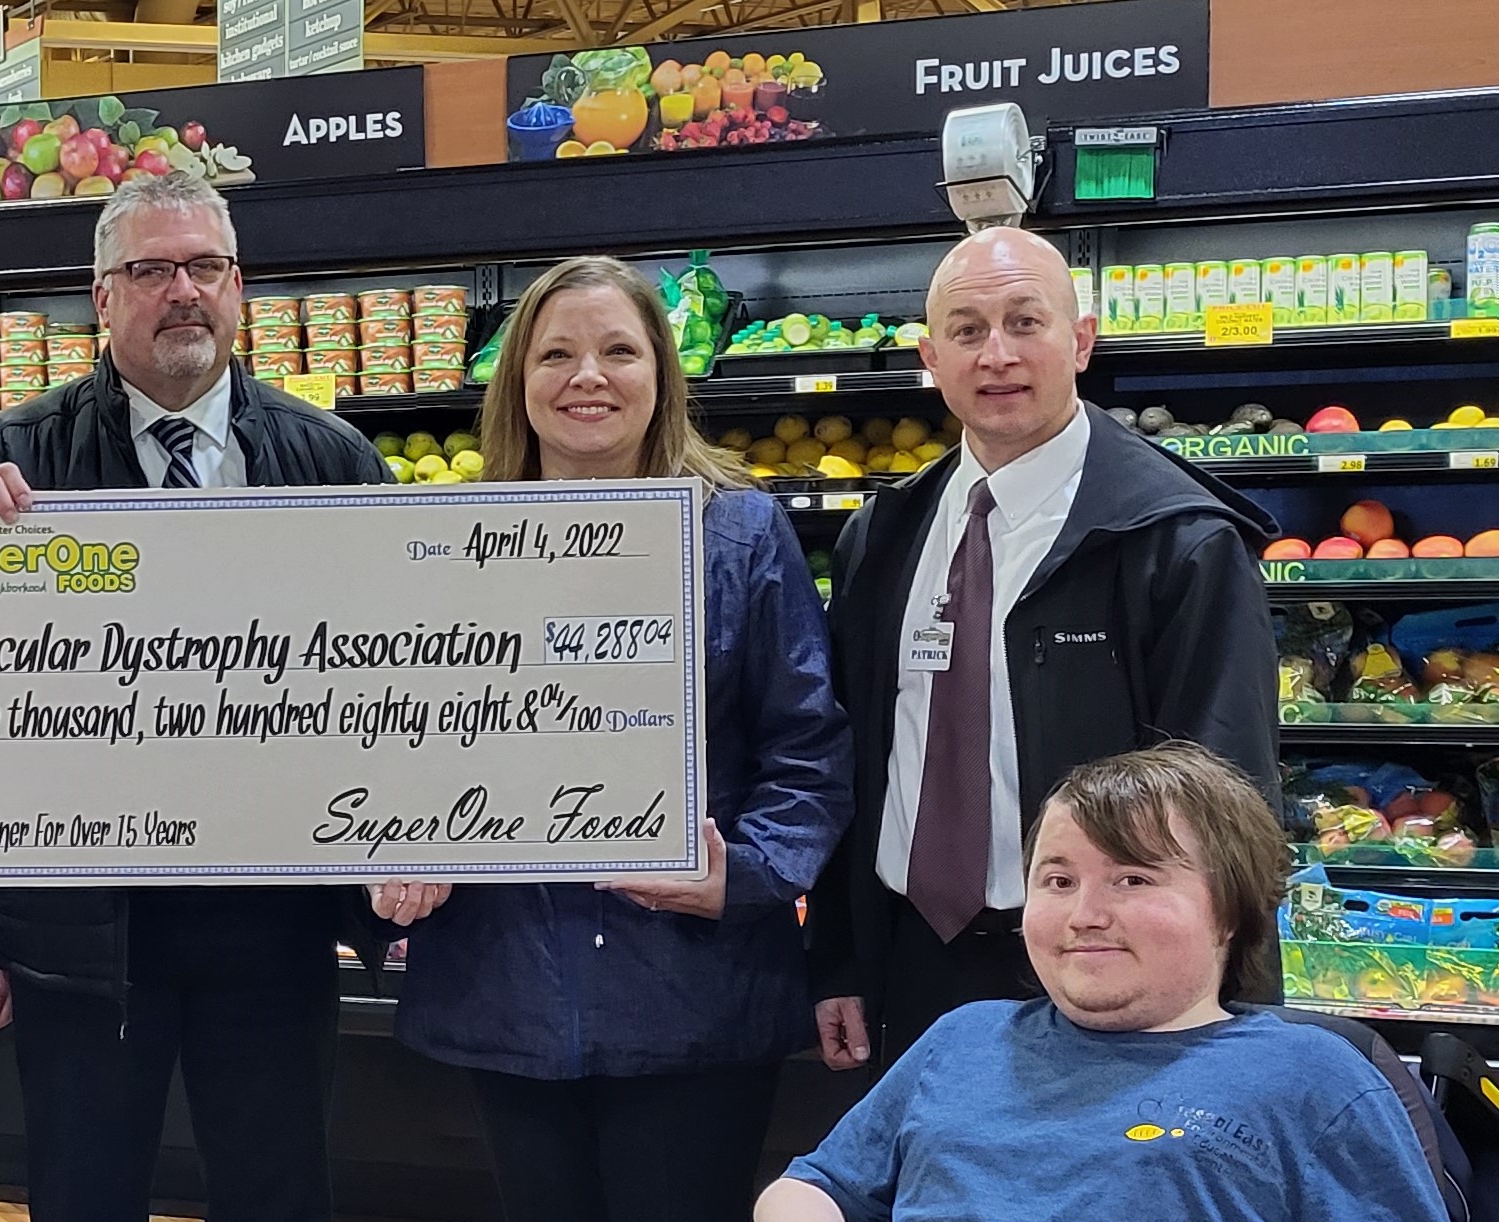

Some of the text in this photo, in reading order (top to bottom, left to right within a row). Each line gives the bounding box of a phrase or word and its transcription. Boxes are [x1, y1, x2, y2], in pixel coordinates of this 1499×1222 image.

[225, 4, 278, 39] institutional
[304, 13, 342, 38] ketchup
[220, 33, 284, 70] kitchen gadgets
[915, 44, 1181, 95] FRUIT JUICES
[283, 111, 403, 147] APPLES
[1220, 325, 1258, 337] 2/3.00
[1161, 434, 1309, 458] ORGANIC
[1474, 457, 1496, 468] 1.69
[1341, 460, 1362, 471] 2.98
[14, 524, 55, 535] Choices.
[406, 519, 625, 569] Date April 4, 2022
[56, 572, 136, 593] FOODS
[101, 618, 291, 686] Dystrophy
[299, 621, 522, 675] Association
[1054, 631, 1107, 644] SIMMS
[8, 689, 145, 746] thousand,
[154, 696, 206, 738] two
[216, 686, 333, 745] hundred
[339, 685, 429, 750] eighty
[438, 684, 512, 748] eight
[605, 708, 675, 732] Dollars
[34, 812, 65, 848] For
[70, 814, 111, 847] Over
[117, 814, 137, 848] 15
[143, 810, 197, 848] Years
[547, 783, 666, 844] Foods
